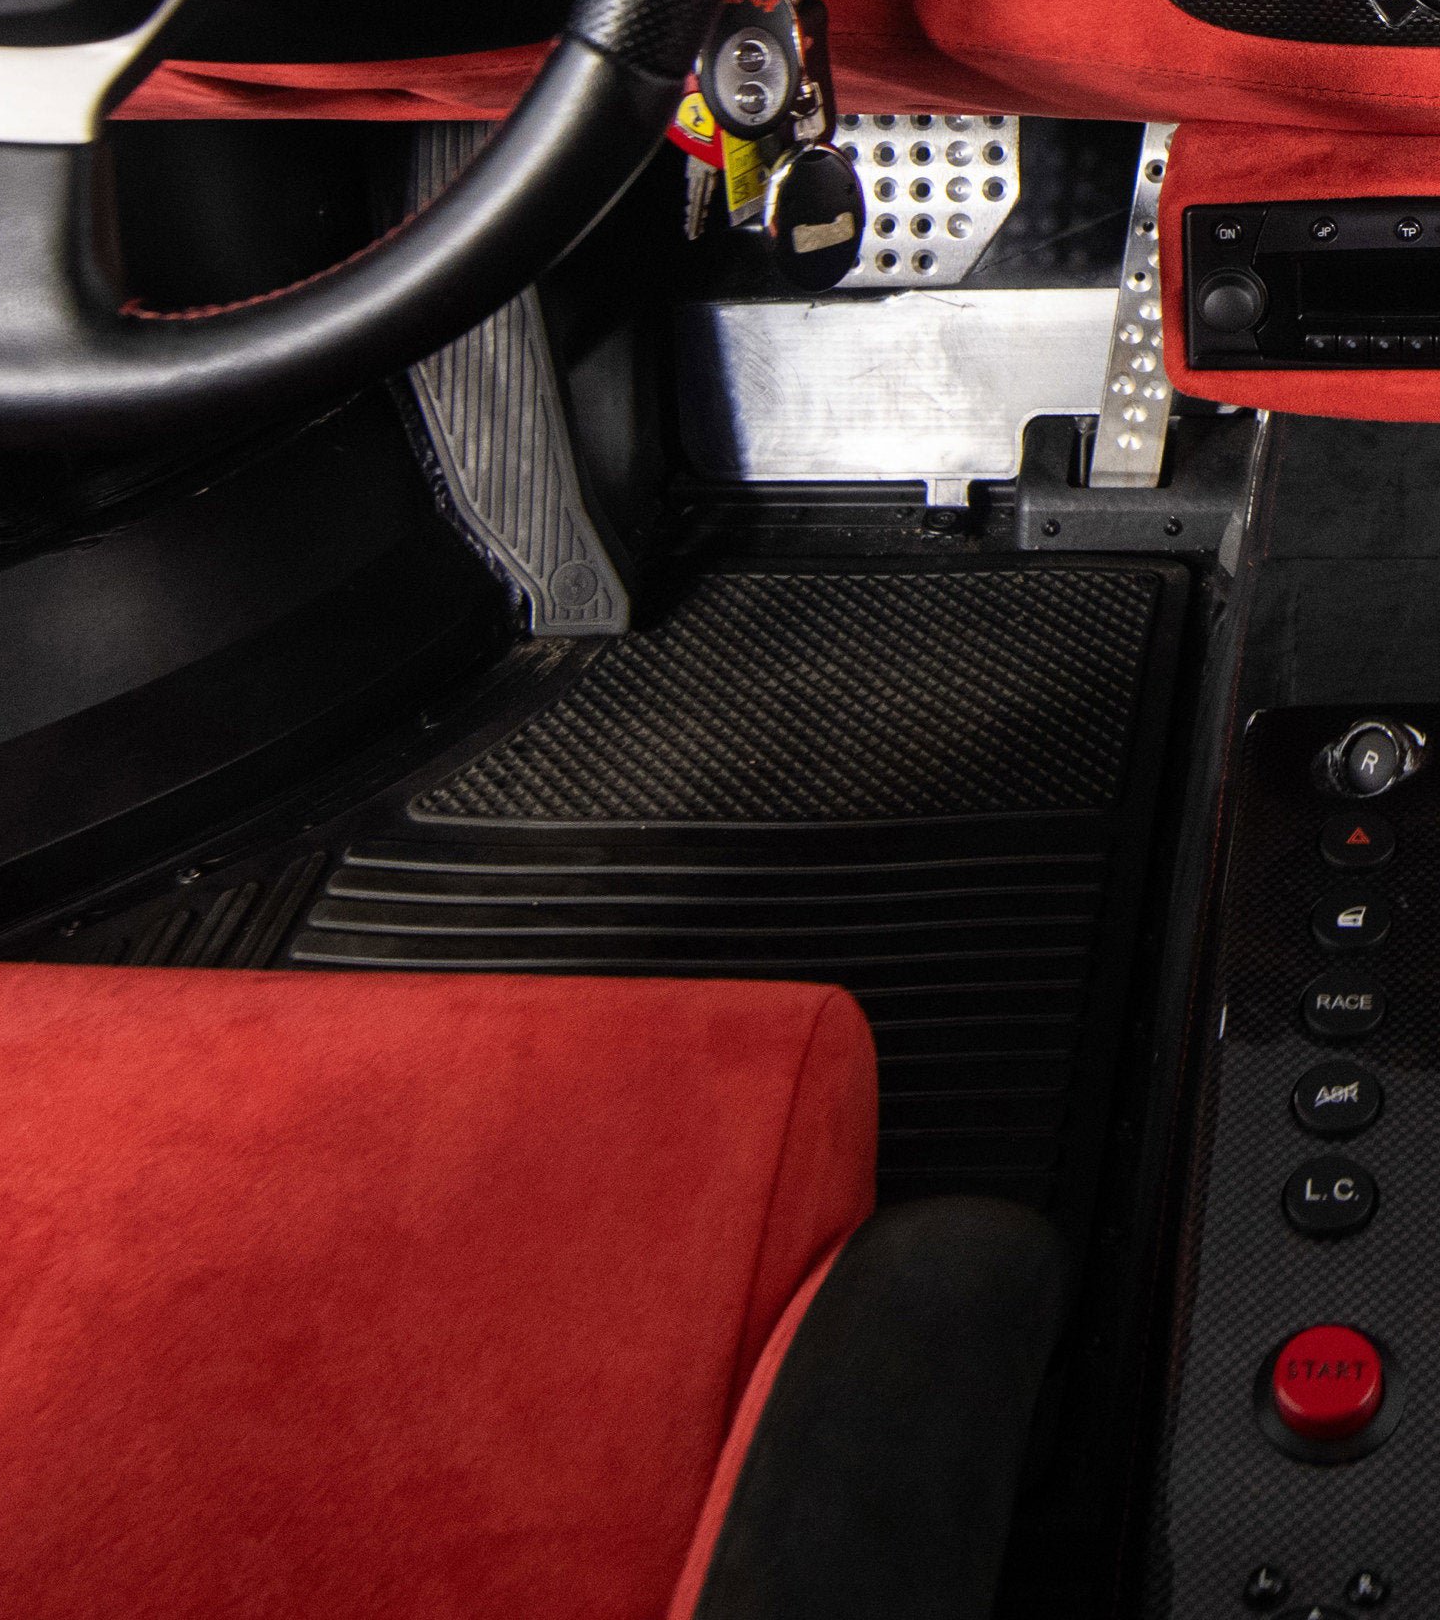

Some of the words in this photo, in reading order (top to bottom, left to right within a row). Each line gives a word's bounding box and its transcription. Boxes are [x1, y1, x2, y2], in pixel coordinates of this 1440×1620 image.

[1219, 228, 1237, 240] ON
[1402, 227, 1417, 238] TP
[1361, 749, 1379, 775] R
[1316, 994, 1373, 1010] RACE
[1288, 1359, 1368, 1380] START
